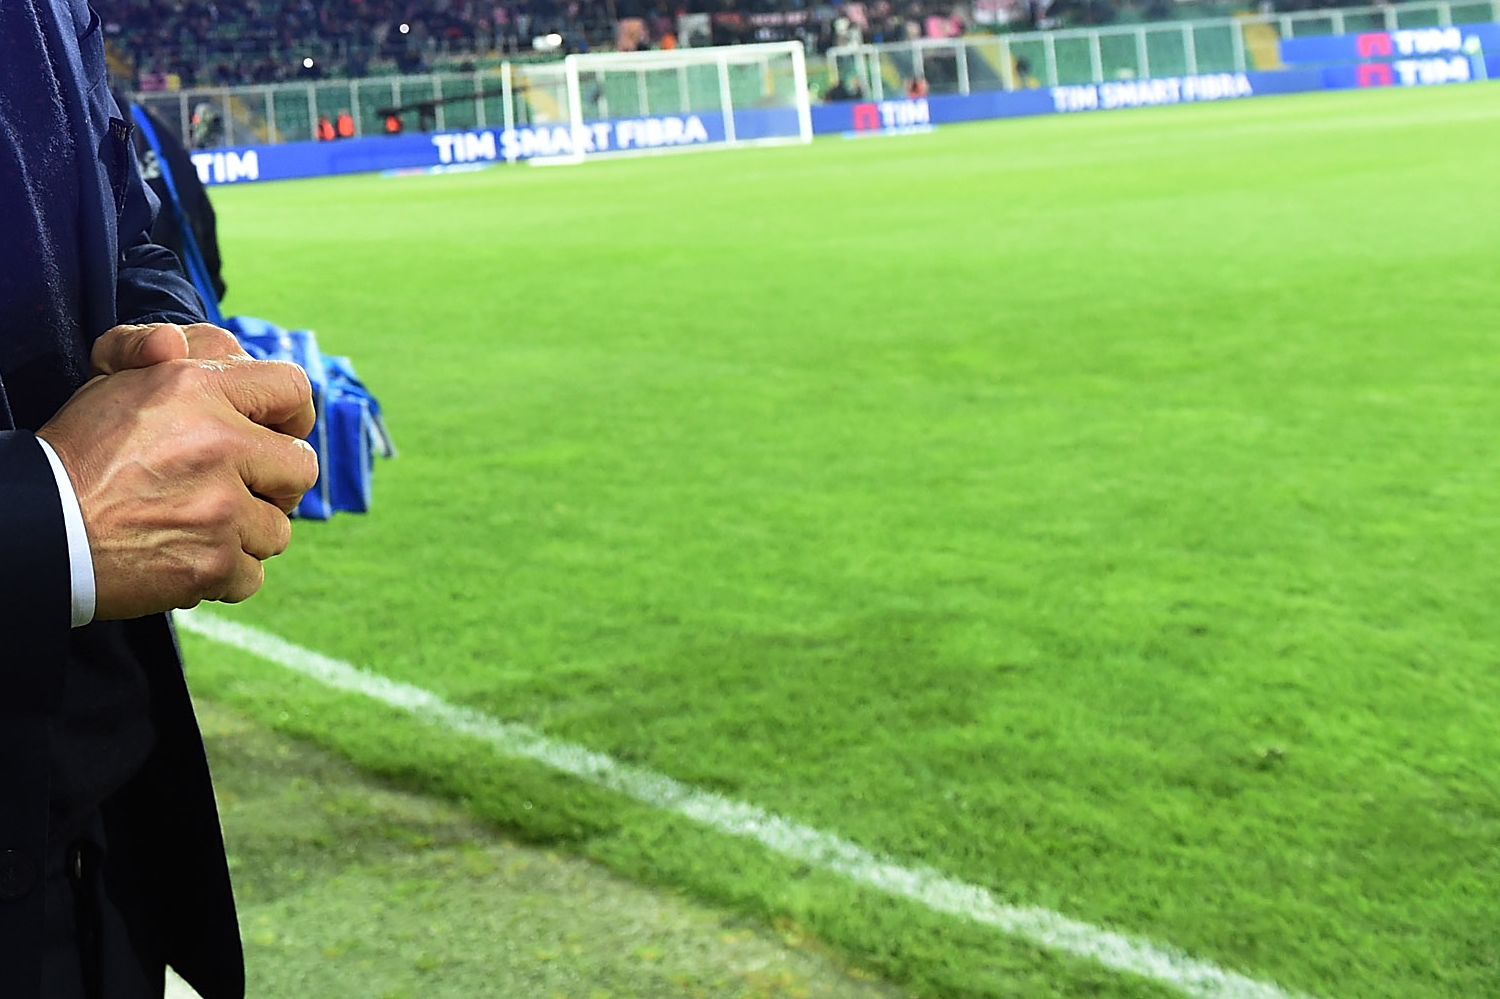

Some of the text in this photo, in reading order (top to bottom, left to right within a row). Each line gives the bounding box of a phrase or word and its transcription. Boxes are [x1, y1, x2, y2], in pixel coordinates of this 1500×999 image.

[1392, 27, 1463, 55] TIM
[1393, 56, 1471, 86] TIM
[1051, 72, 1254, 113] TIM SMART FIBRA
[879, 98, 931, 126] TIM
[431, 115, 709, 164] TIM SMART FIBRA
[191, 150, 259, 184] TIM
